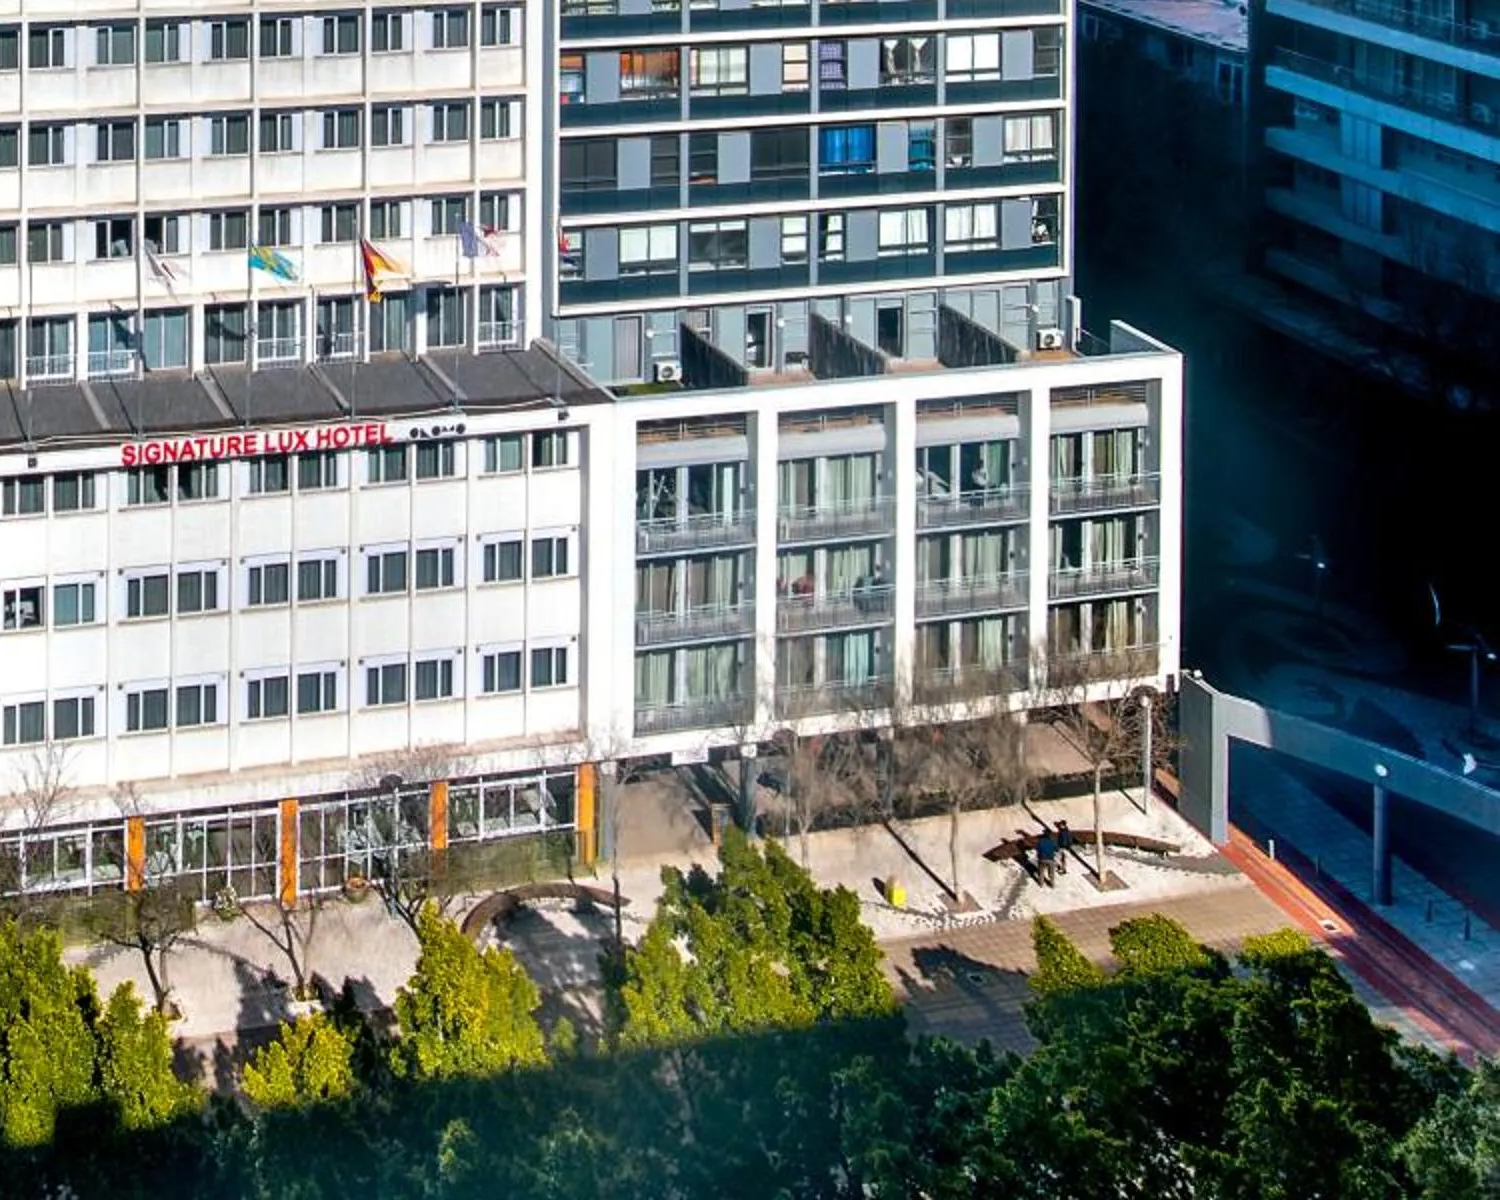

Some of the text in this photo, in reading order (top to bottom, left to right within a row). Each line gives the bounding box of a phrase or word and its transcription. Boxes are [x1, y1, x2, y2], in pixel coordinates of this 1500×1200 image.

[121, 433, 257, 466] SIGNATURE
[264, 429, 309, 453] LUX
[316, 423, 394, 449] HOTEL
